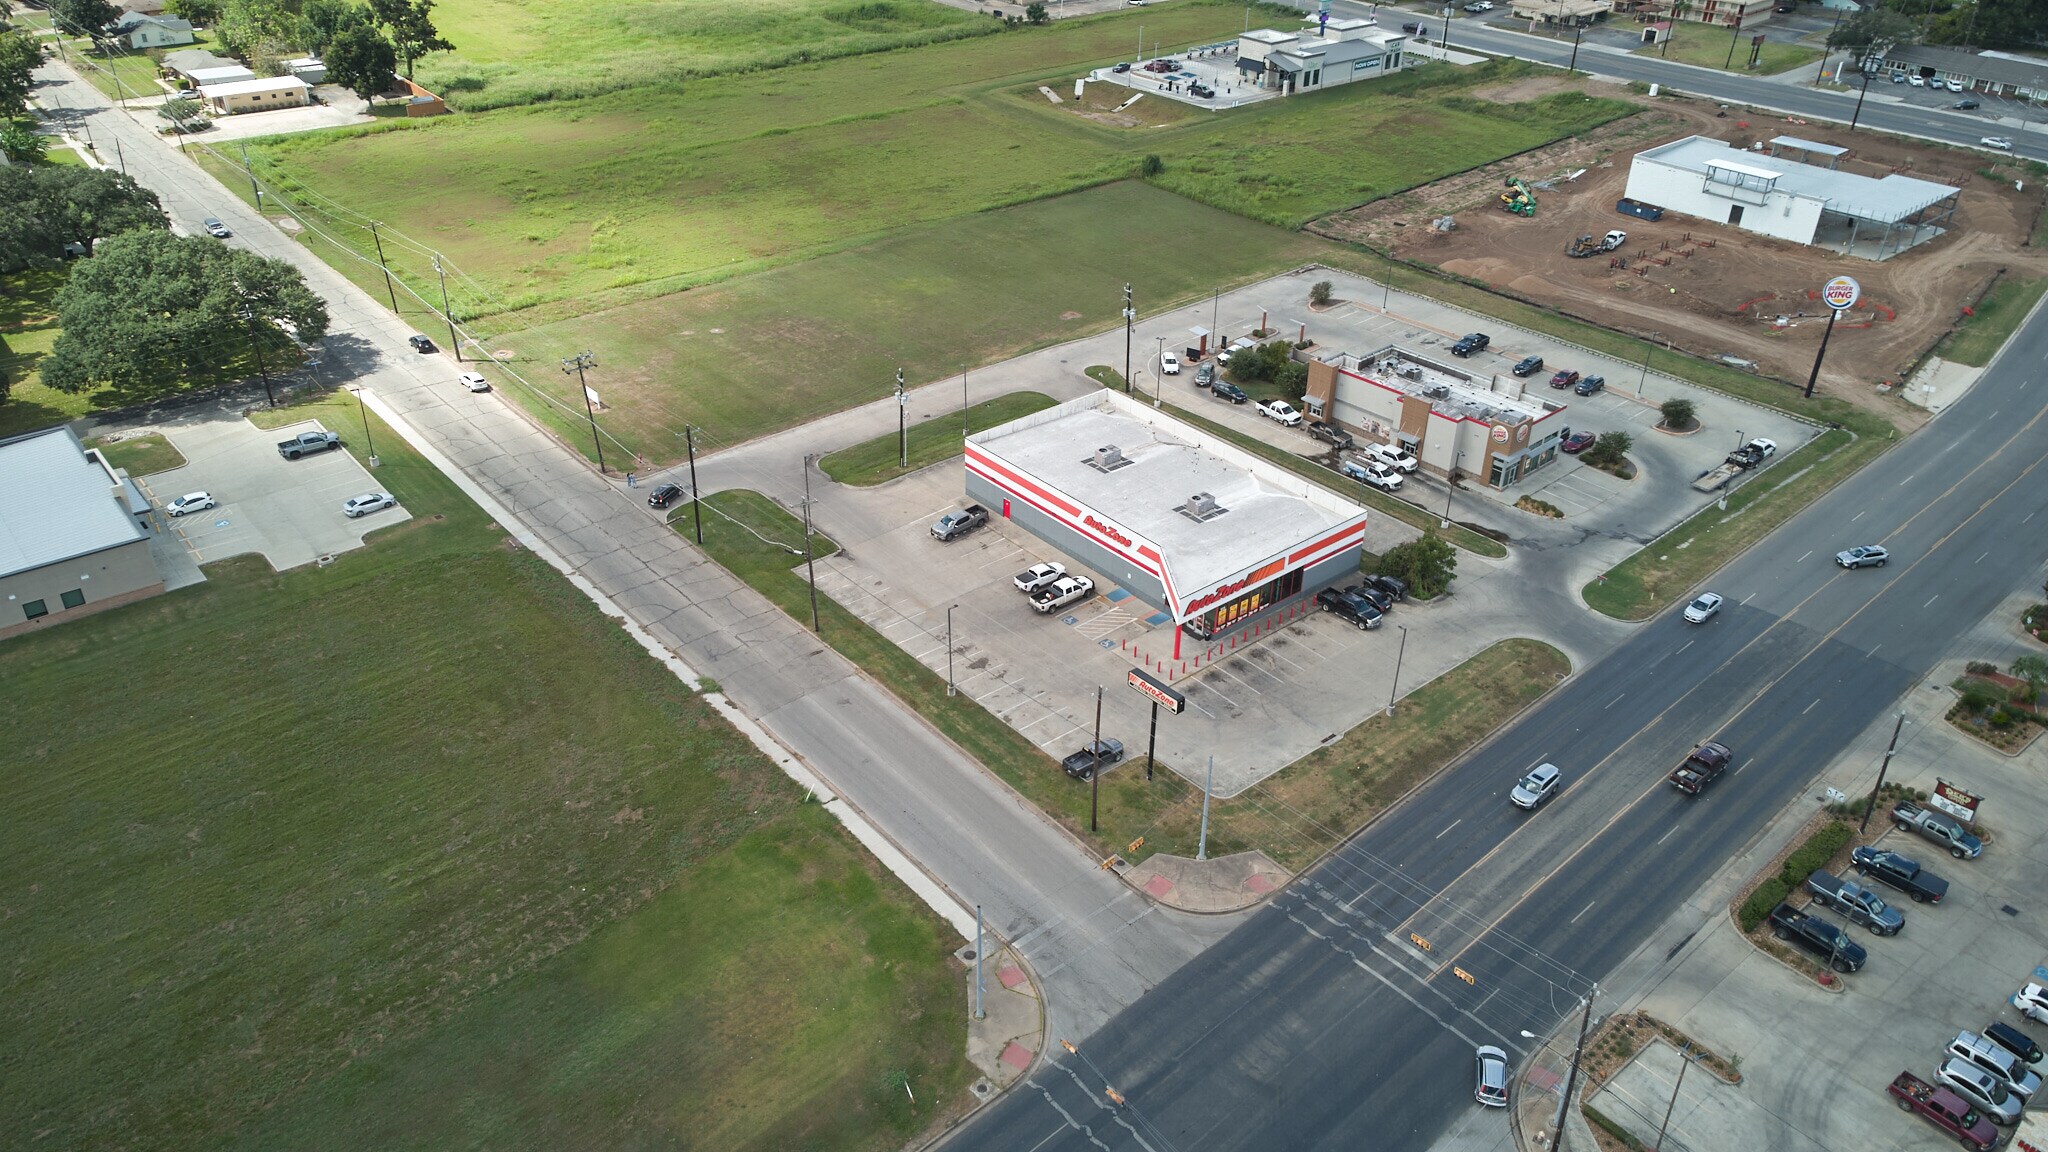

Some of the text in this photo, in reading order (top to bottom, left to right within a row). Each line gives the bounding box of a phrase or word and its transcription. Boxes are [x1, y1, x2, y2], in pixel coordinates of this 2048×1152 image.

[1827, 291, 1852, 299] KING
[1083, 515, 1132, 547] AutoZone
[1184, 579, 1246, 617] AutoZone
[1139, 681, 1174, 706] AutoZone
